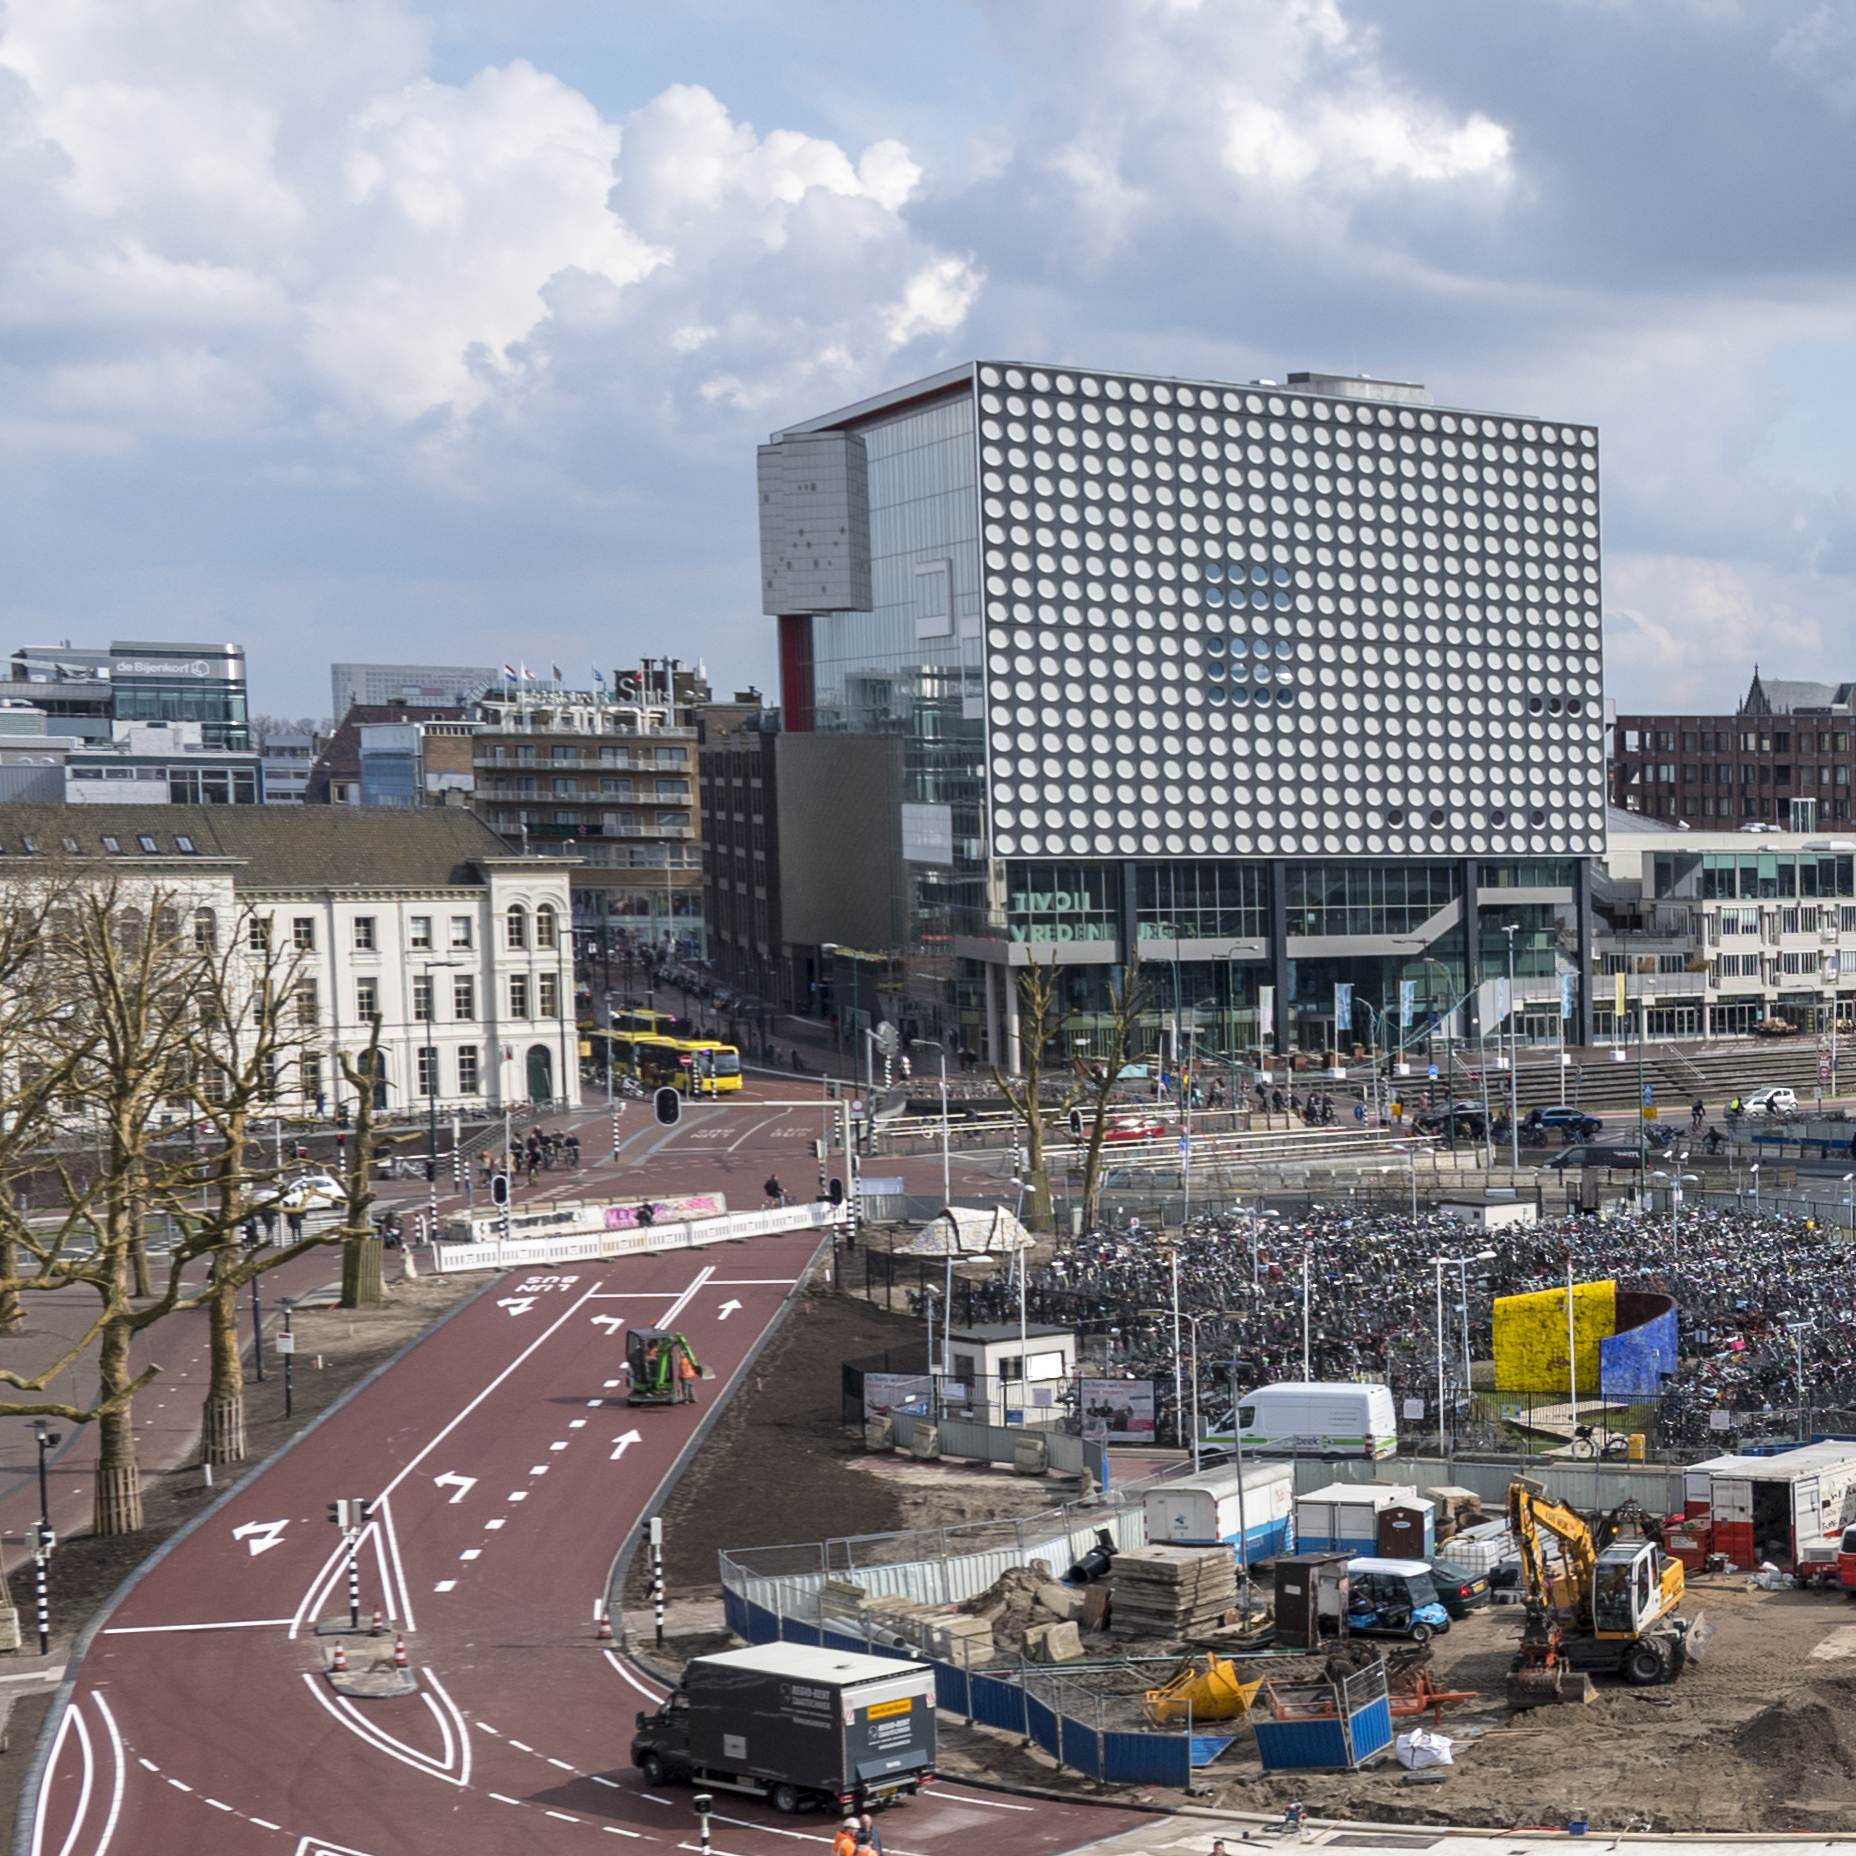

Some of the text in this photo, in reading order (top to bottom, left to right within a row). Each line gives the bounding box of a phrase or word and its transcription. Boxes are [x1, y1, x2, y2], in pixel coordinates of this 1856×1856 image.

[117, 661, 189, 674] de Bijenkorf
[1011, 891, 1091, 912] TIVOLI
